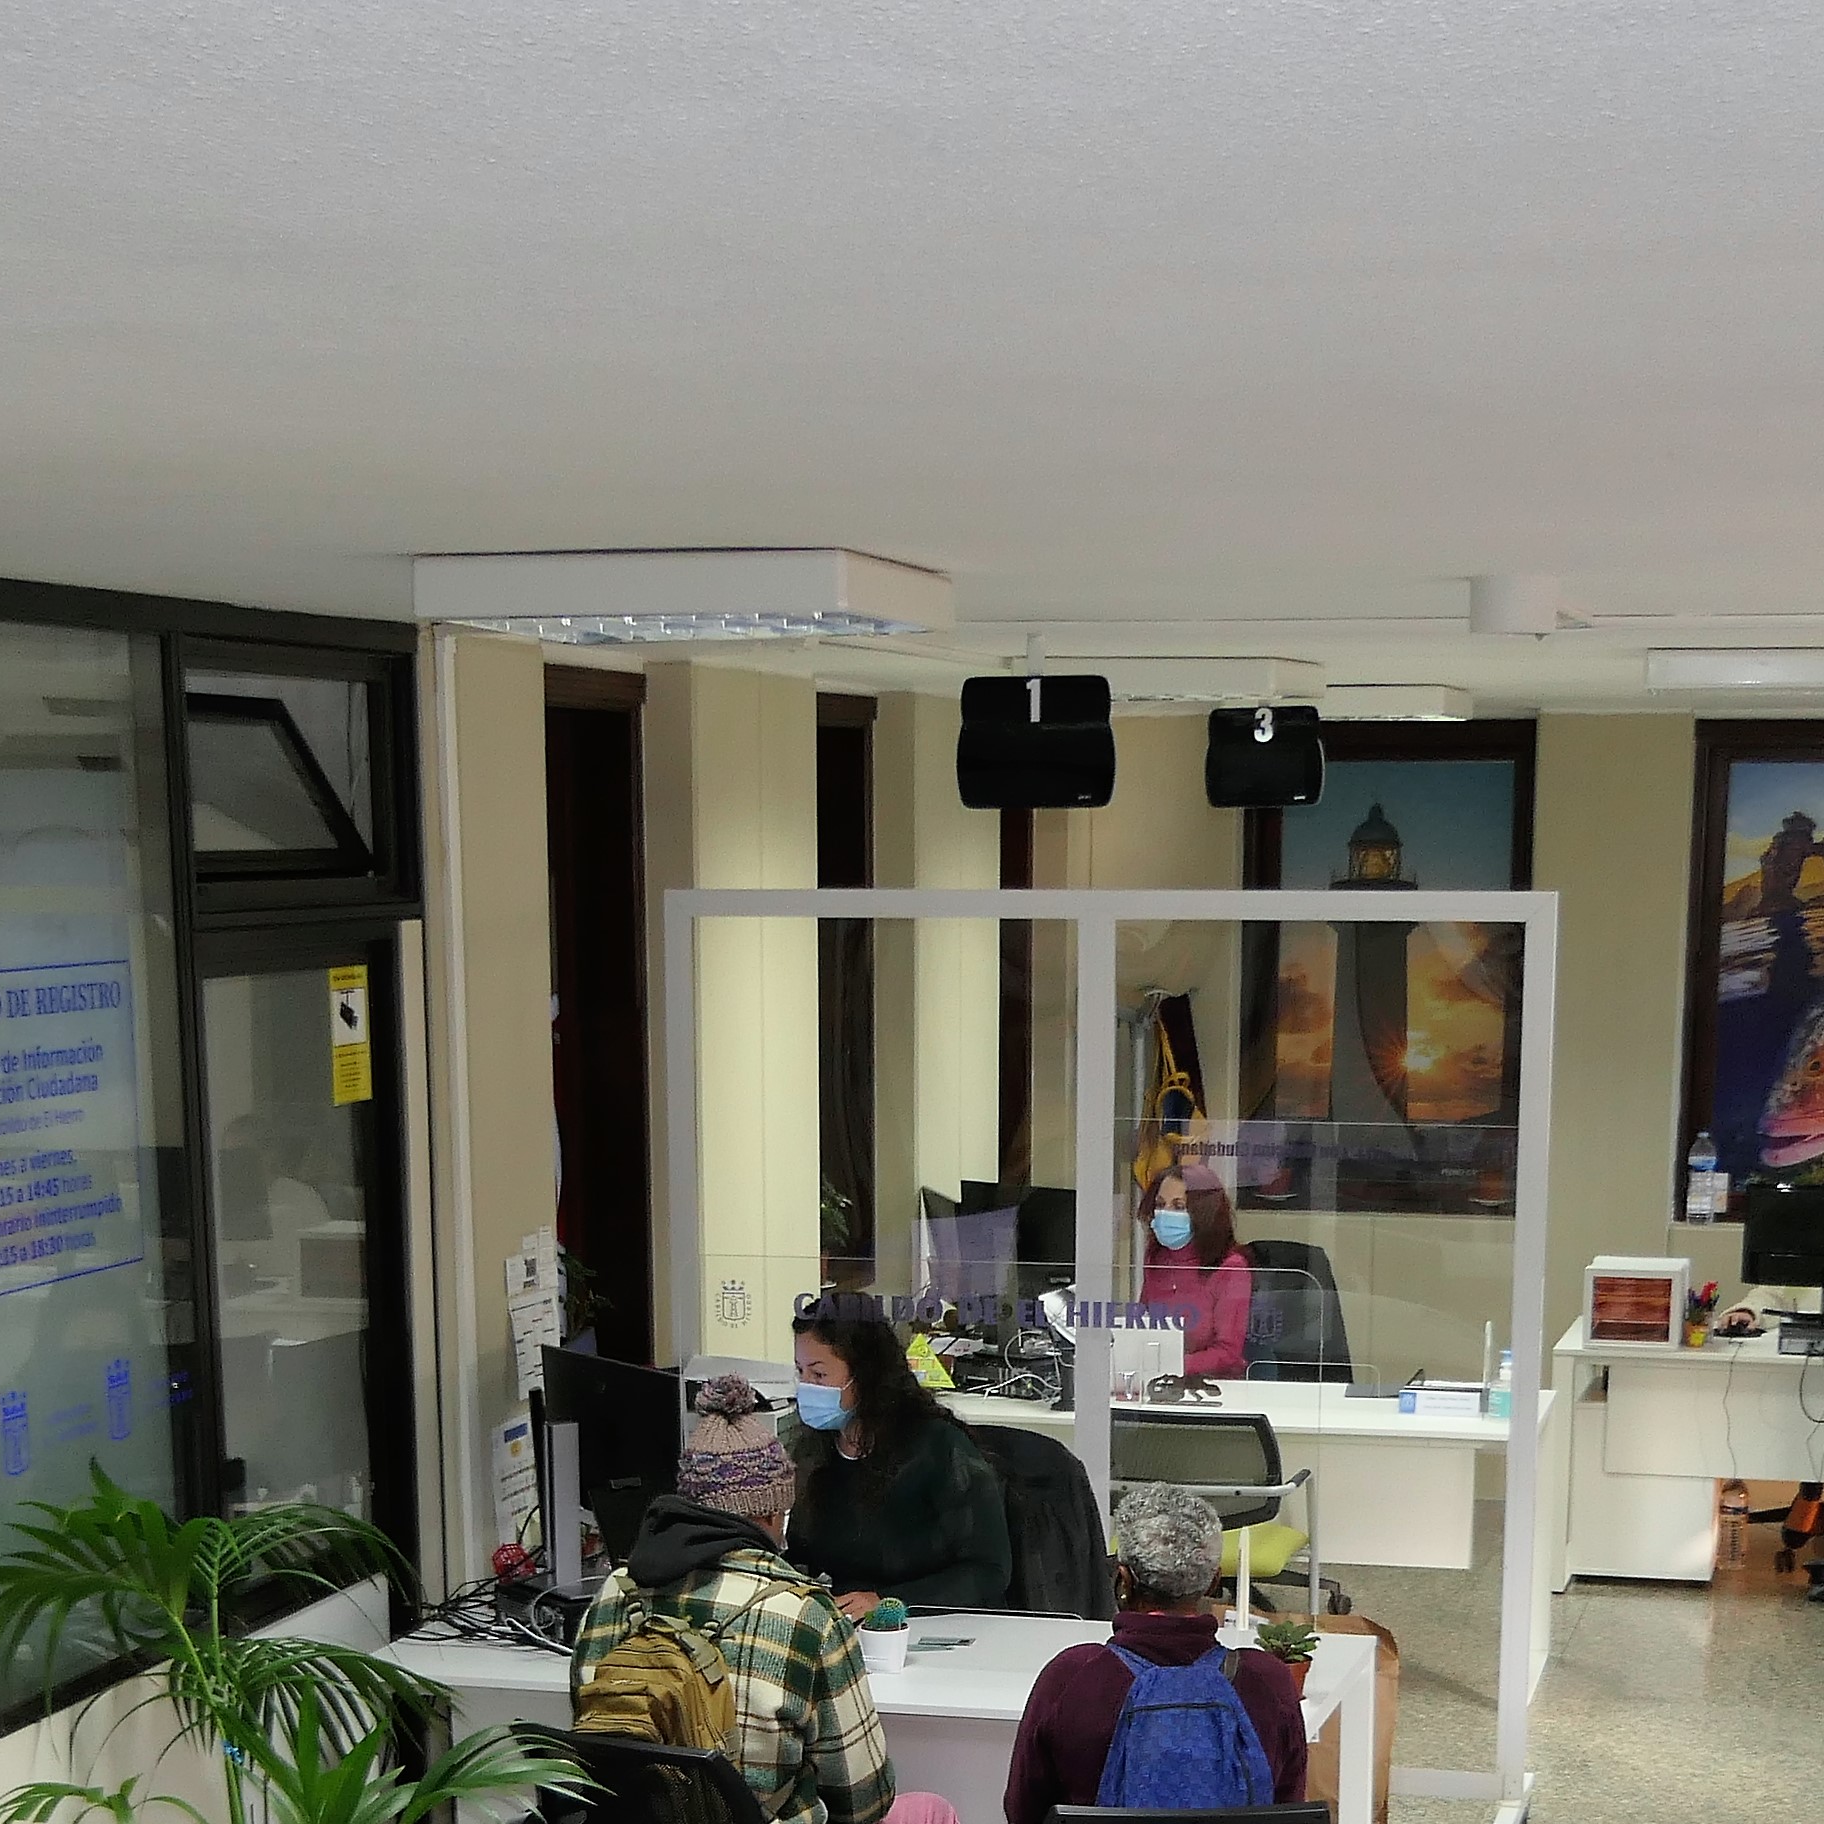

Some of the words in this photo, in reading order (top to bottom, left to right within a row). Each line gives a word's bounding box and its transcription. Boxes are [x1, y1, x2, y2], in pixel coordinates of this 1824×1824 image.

[1026, 678, 1042, 723] 1
[1253, 707, 1274, 743] 3
[6, 989, 29, 1018] DE
[36, 981, 121, 1016] REGISTRO
[1, 1050, 19, 1073] de
[23, 1037, 103, 1072] Información
[28, 1072, 98, 1101] Ciudadana
[1066, 1301, 1200, 1331] HIERRO
